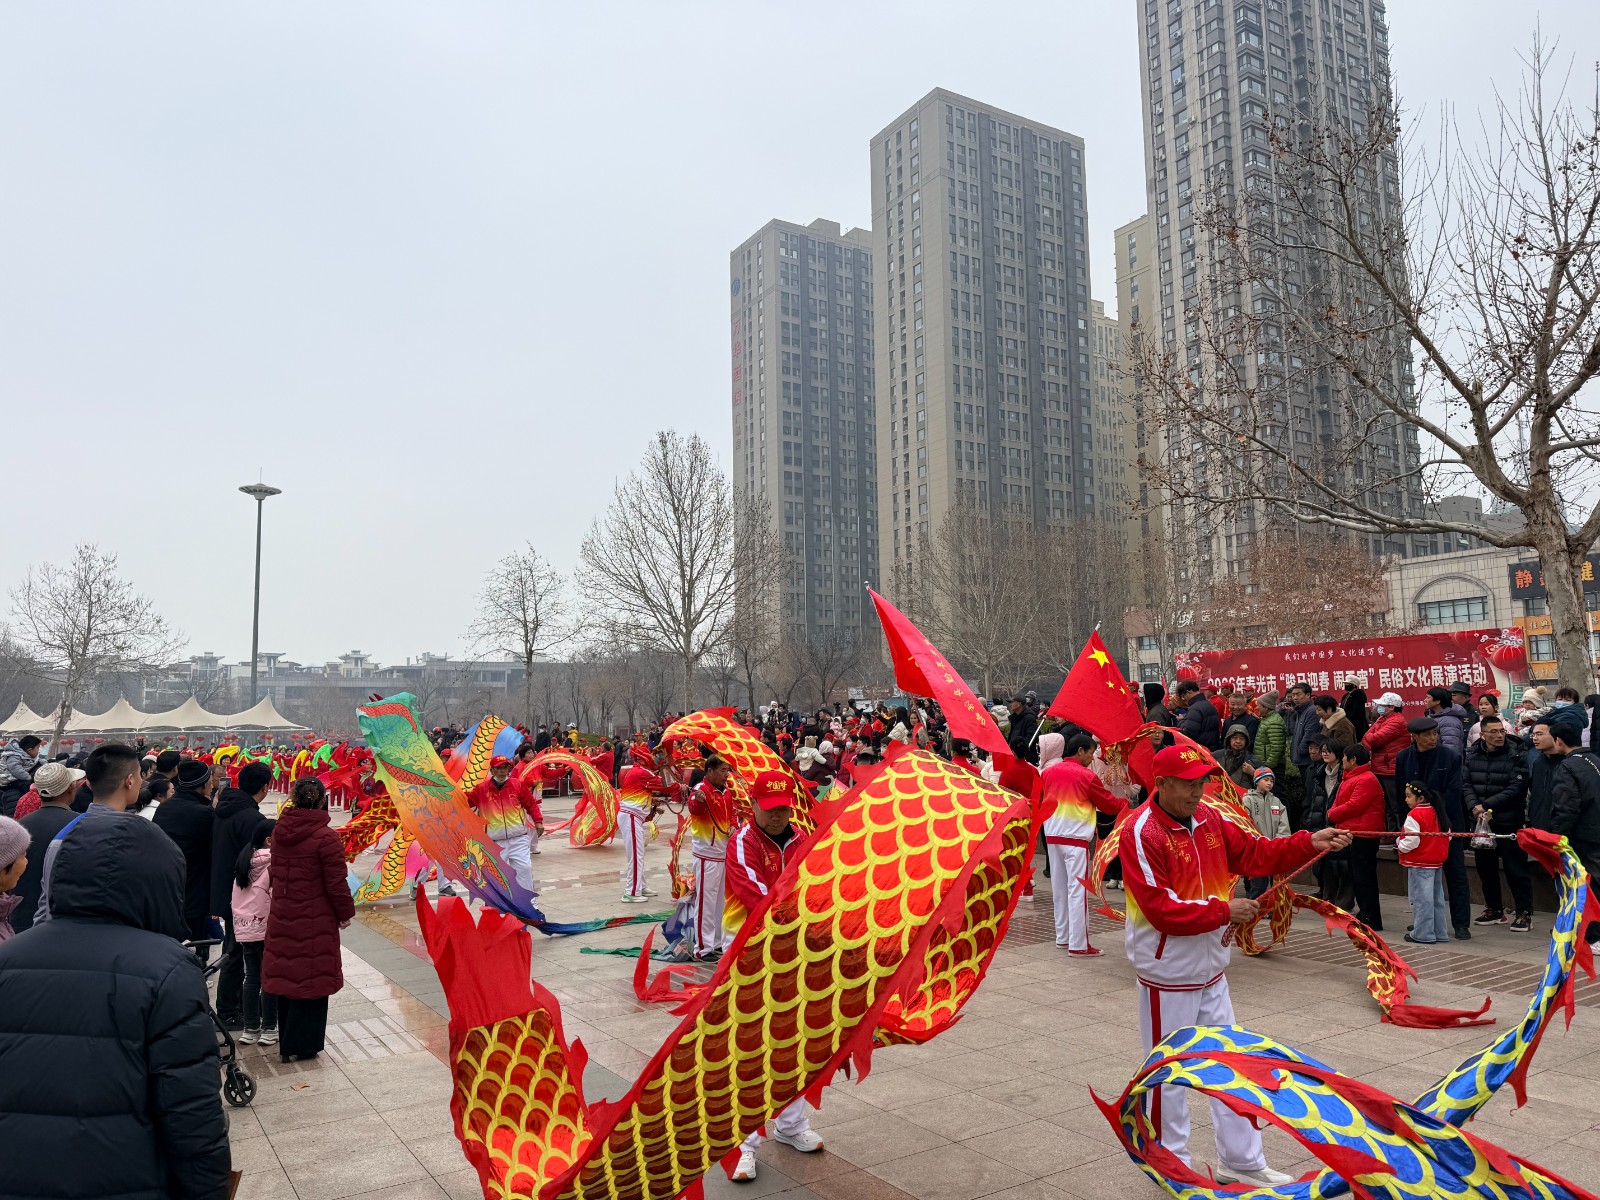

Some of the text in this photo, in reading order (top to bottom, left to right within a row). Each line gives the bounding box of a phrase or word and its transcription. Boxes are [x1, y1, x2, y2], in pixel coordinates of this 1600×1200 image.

[1284, 649, 1334, 661] 我们的中国梦
[1333, 662, 1487, 691] 闹宵”民俗文化展演活动
[766, 780, 788, 791] 中国梦
